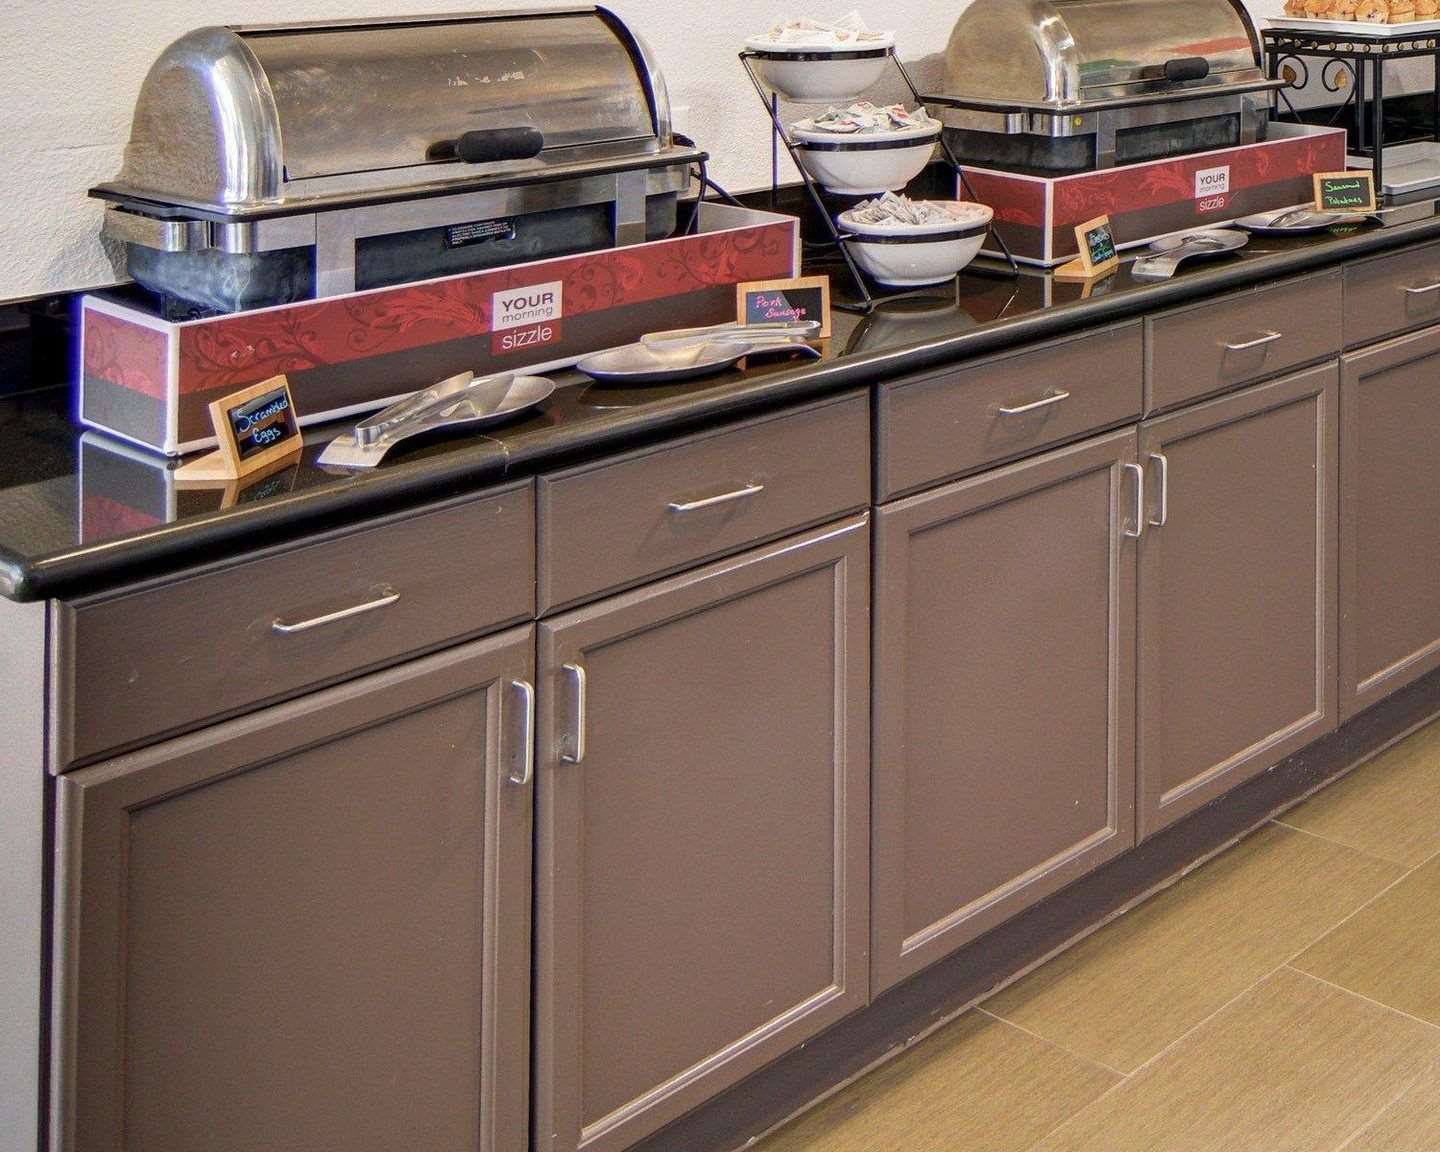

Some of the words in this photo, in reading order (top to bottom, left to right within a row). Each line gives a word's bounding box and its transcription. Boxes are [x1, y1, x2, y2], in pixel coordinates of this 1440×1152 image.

[1200, 173, 1225, 185] YOUR
[1200, 195, 1225, 212] sizzle
[502, 292, 554, 312] YOUR
[755, 295, 783, 308] Pork
[502, 306, 554, 323] morning
[502, 325, 553, 349] sizzle
[237, 391, 288, 433] Scrambled
[252, 427, 281, 444] Eggs
